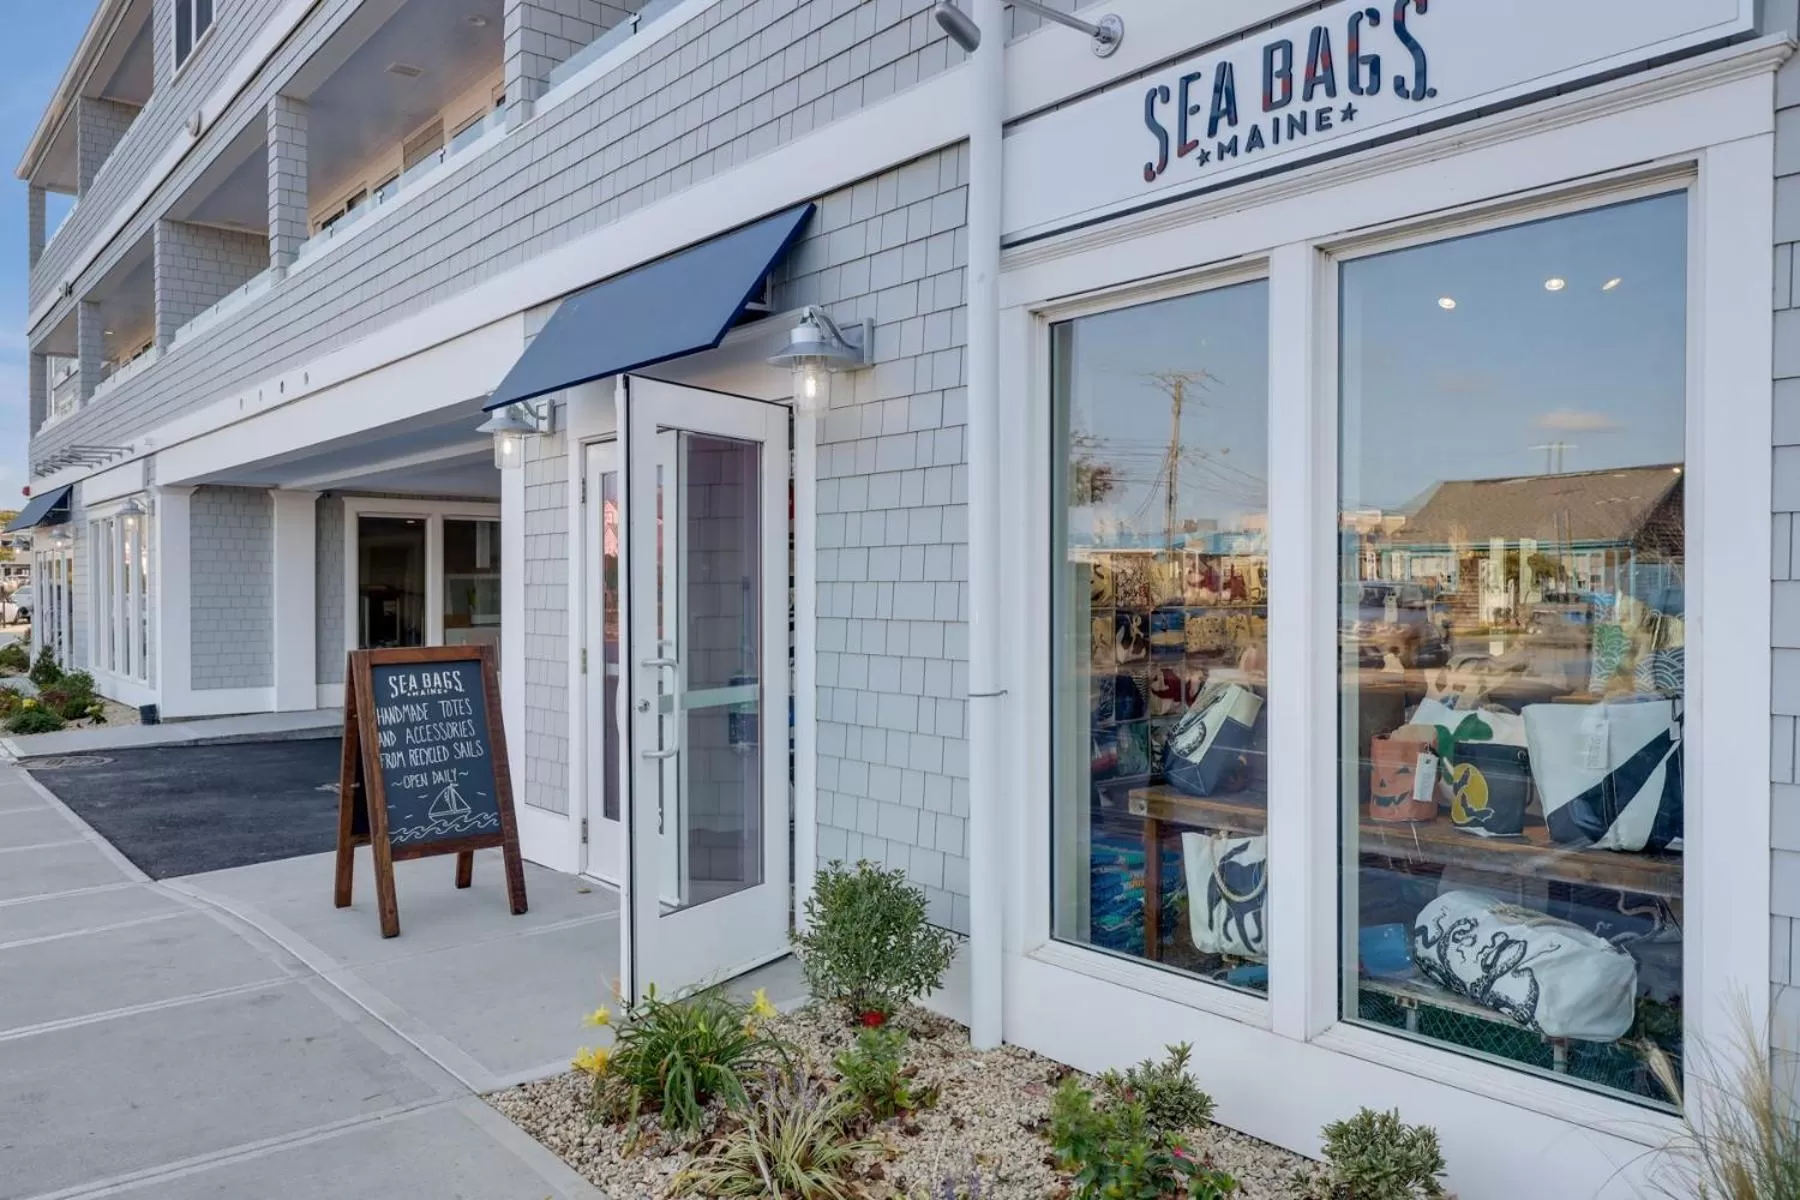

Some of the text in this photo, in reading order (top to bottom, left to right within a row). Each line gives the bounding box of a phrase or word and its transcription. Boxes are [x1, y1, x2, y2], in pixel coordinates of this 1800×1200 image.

[1144, 60, 1238, 182] SEA
[1217, 106, 1333, 161] MAINE
[388, 674, 418, 698] SEA
[376, 698, 473, 726] HANDMADE TOTES
[377, 719, 476, 748] AND ACCESSORIES
[379, 740, 484, 769] FROM RECYCLED SAILS
[403, 768, 457, 789] OPEN DAILY
